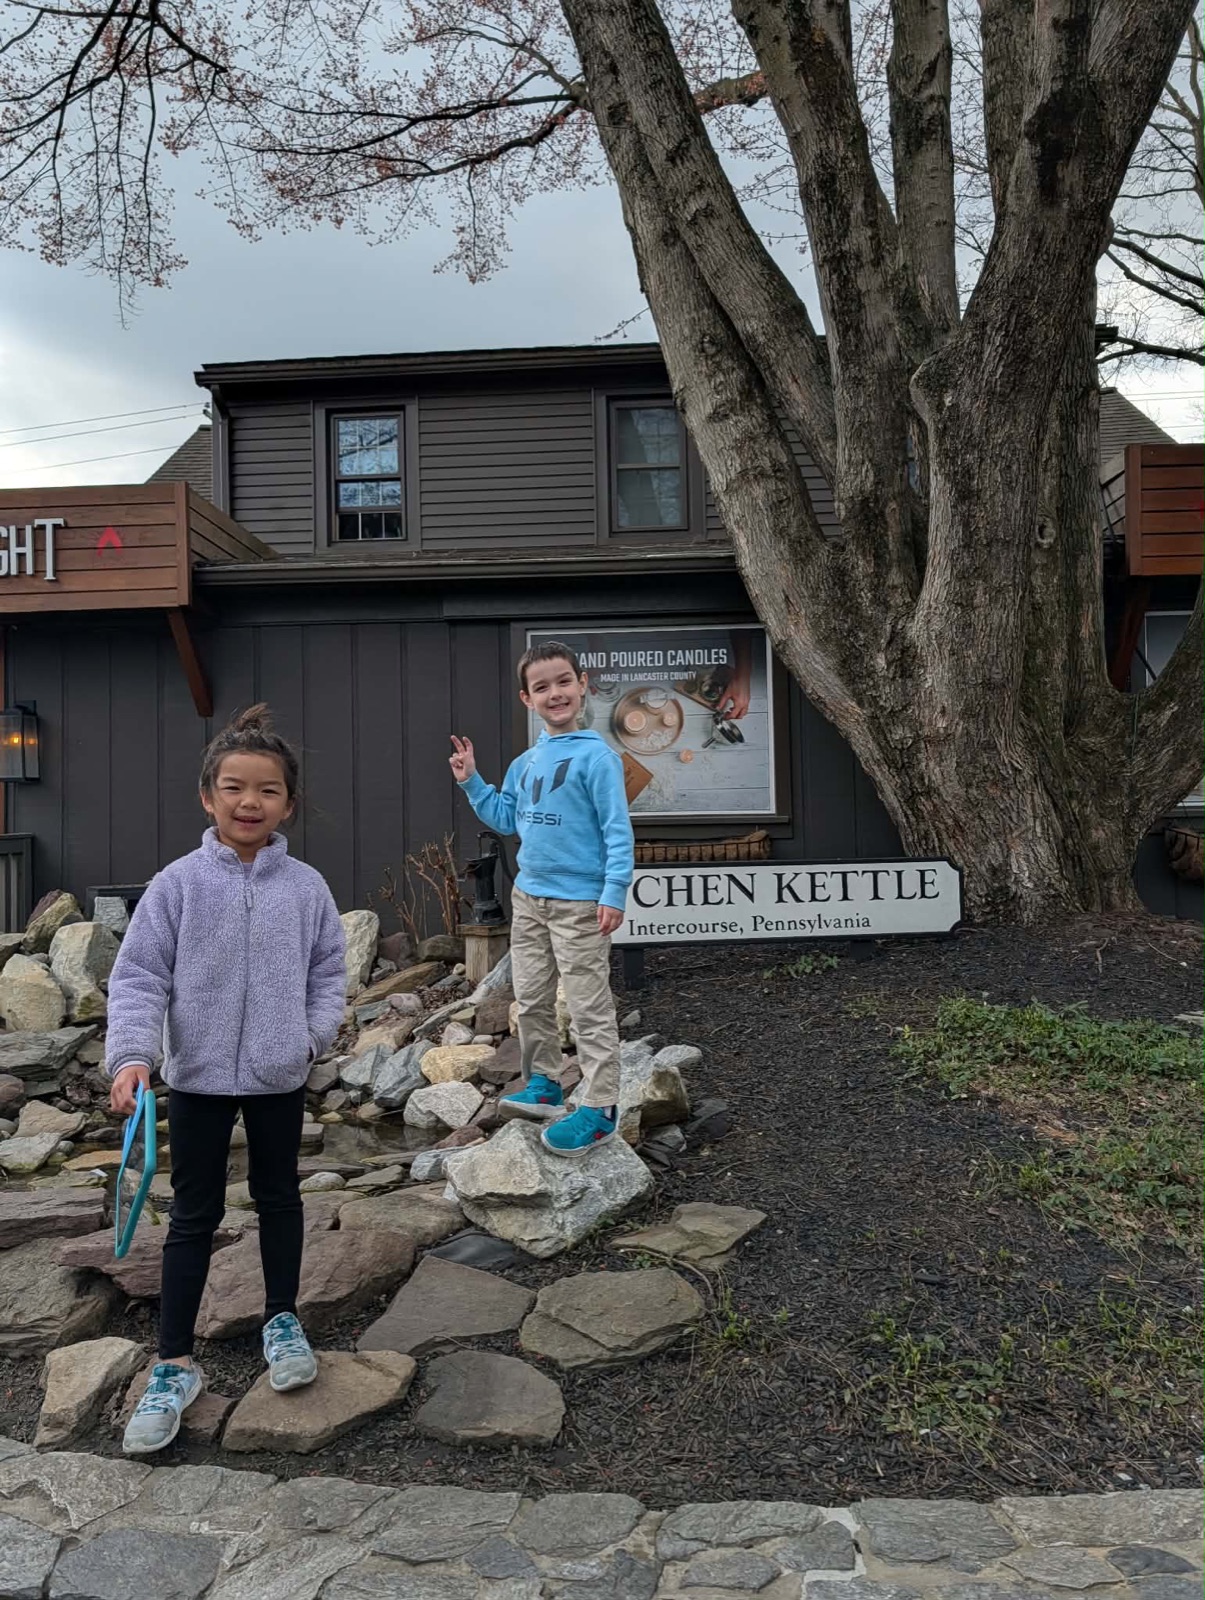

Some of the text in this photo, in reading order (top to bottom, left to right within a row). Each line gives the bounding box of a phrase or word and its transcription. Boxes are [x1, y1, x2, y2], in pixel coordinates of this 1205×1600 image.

[576, 648, 727, 668] AND POURED CANDLES
[600, 671, 697, 683] MADE IN LANCASTER COUNTY
[632, 868, 940, 908] CHEN KETTLE
[628, 912, 872, 936] Intercourse, Pennsylvania
